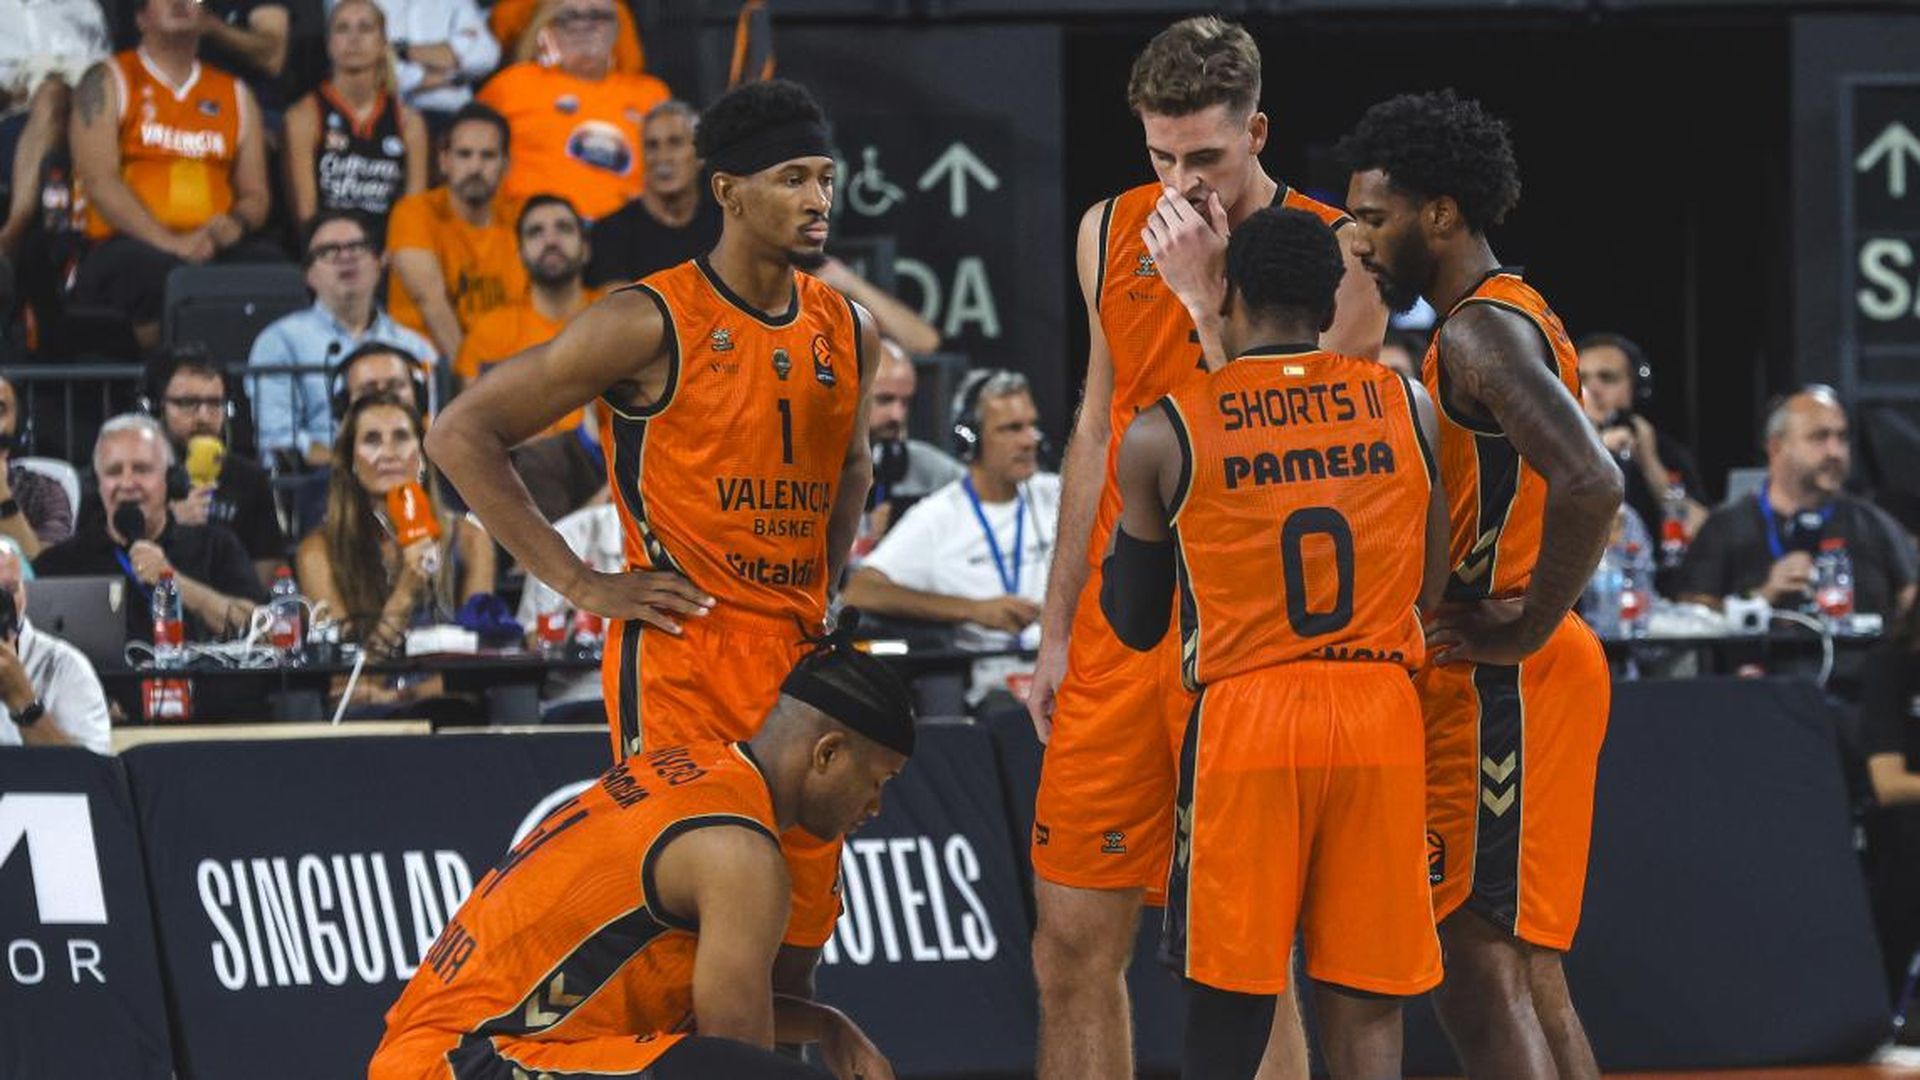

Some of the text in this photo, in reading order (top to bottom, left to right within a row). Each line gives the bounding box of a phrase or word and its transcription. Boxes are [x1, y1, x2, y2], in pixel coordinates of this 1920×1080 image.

[1857, 238, 1920, 320] S
[777, 398, 793, 464] 1
[1219, 382, 1356, 431] SHORTS
[1223, 441, 1396, 489] PAMESA
[716, 477, 830, 512] VALENCIA
[754, 518, 816, 538] BASKET
[1281, 507, 1353, 637] 0
[823, 834, 998, 966] OTELS
